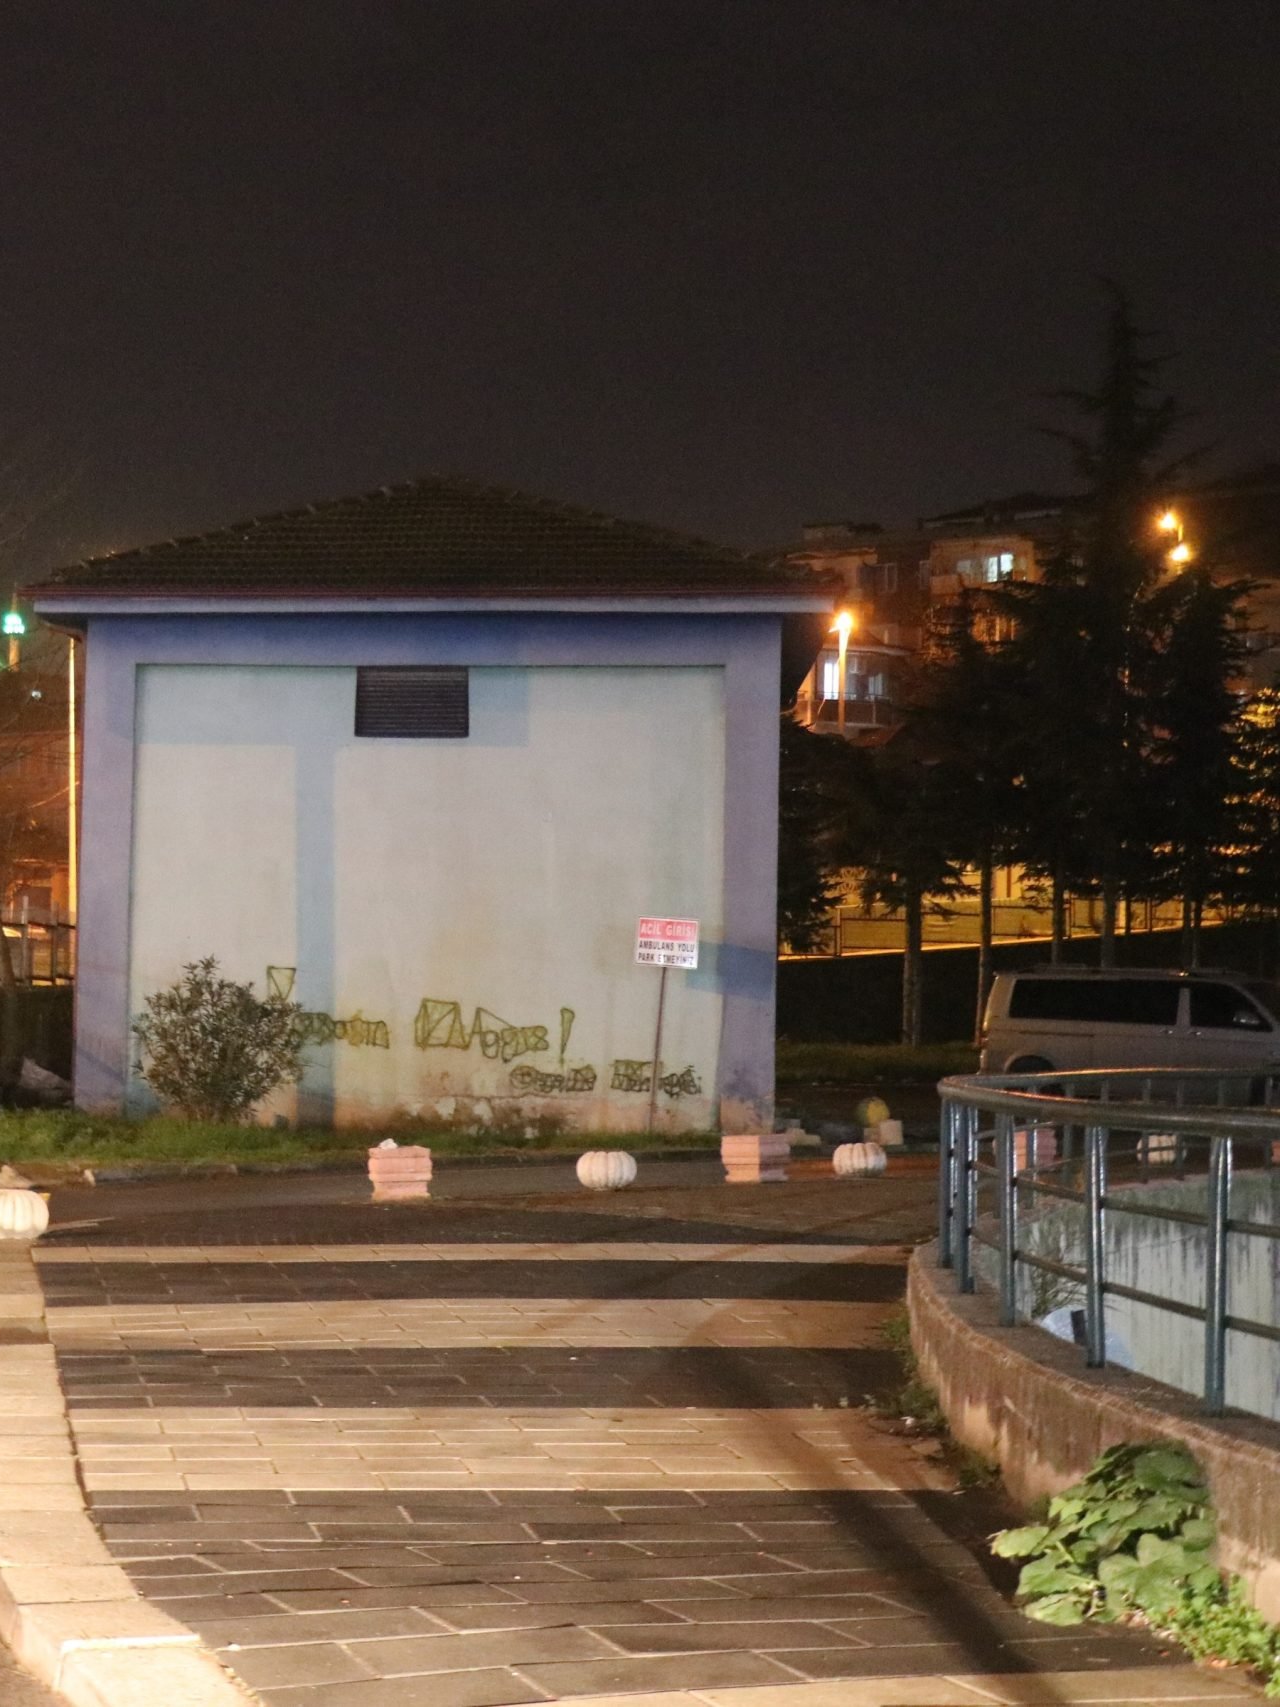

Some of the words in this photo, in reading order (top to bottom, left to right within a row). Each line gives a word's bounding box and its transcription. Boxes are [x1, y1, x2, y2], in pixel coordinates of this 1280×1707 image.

[638, 940, 674, 952] AMBULANS
[677, 943, 696, 953] YOLU
[637, 952, 655, 962] PARK
